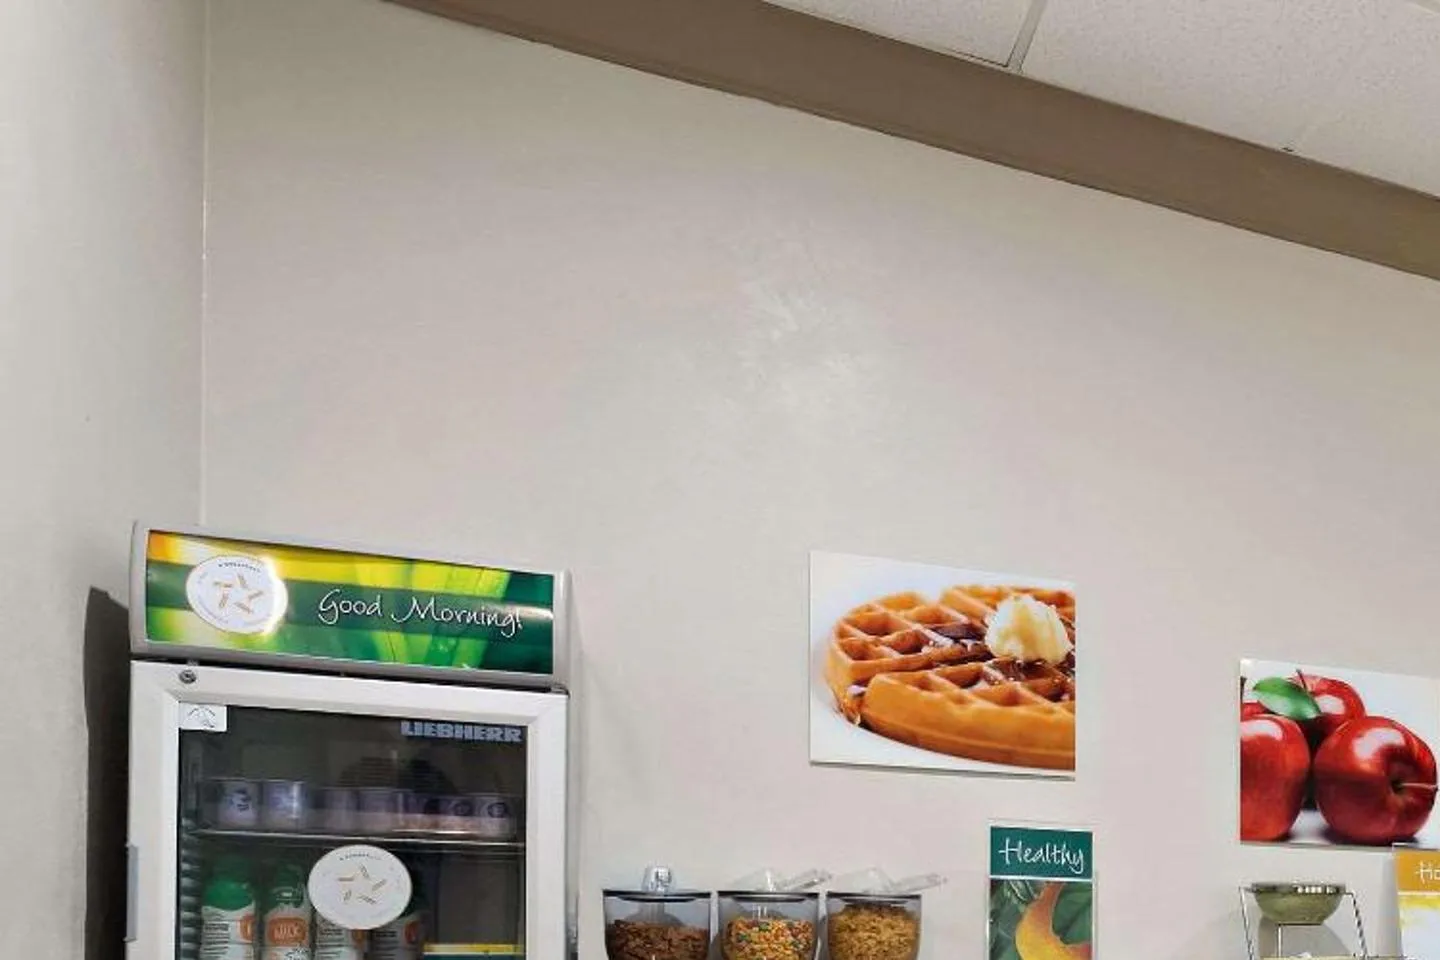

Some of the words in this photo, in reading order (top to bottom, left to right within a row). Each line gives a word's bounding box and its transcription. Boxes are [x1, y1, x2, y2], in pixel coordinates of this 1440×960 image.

[318, 588, 383, 625] Good
[390, 597, 523, 638] Morning!
[400, 720, 522, 742] LIEBHERR
[998, 837, 1084, 875] Healthy
